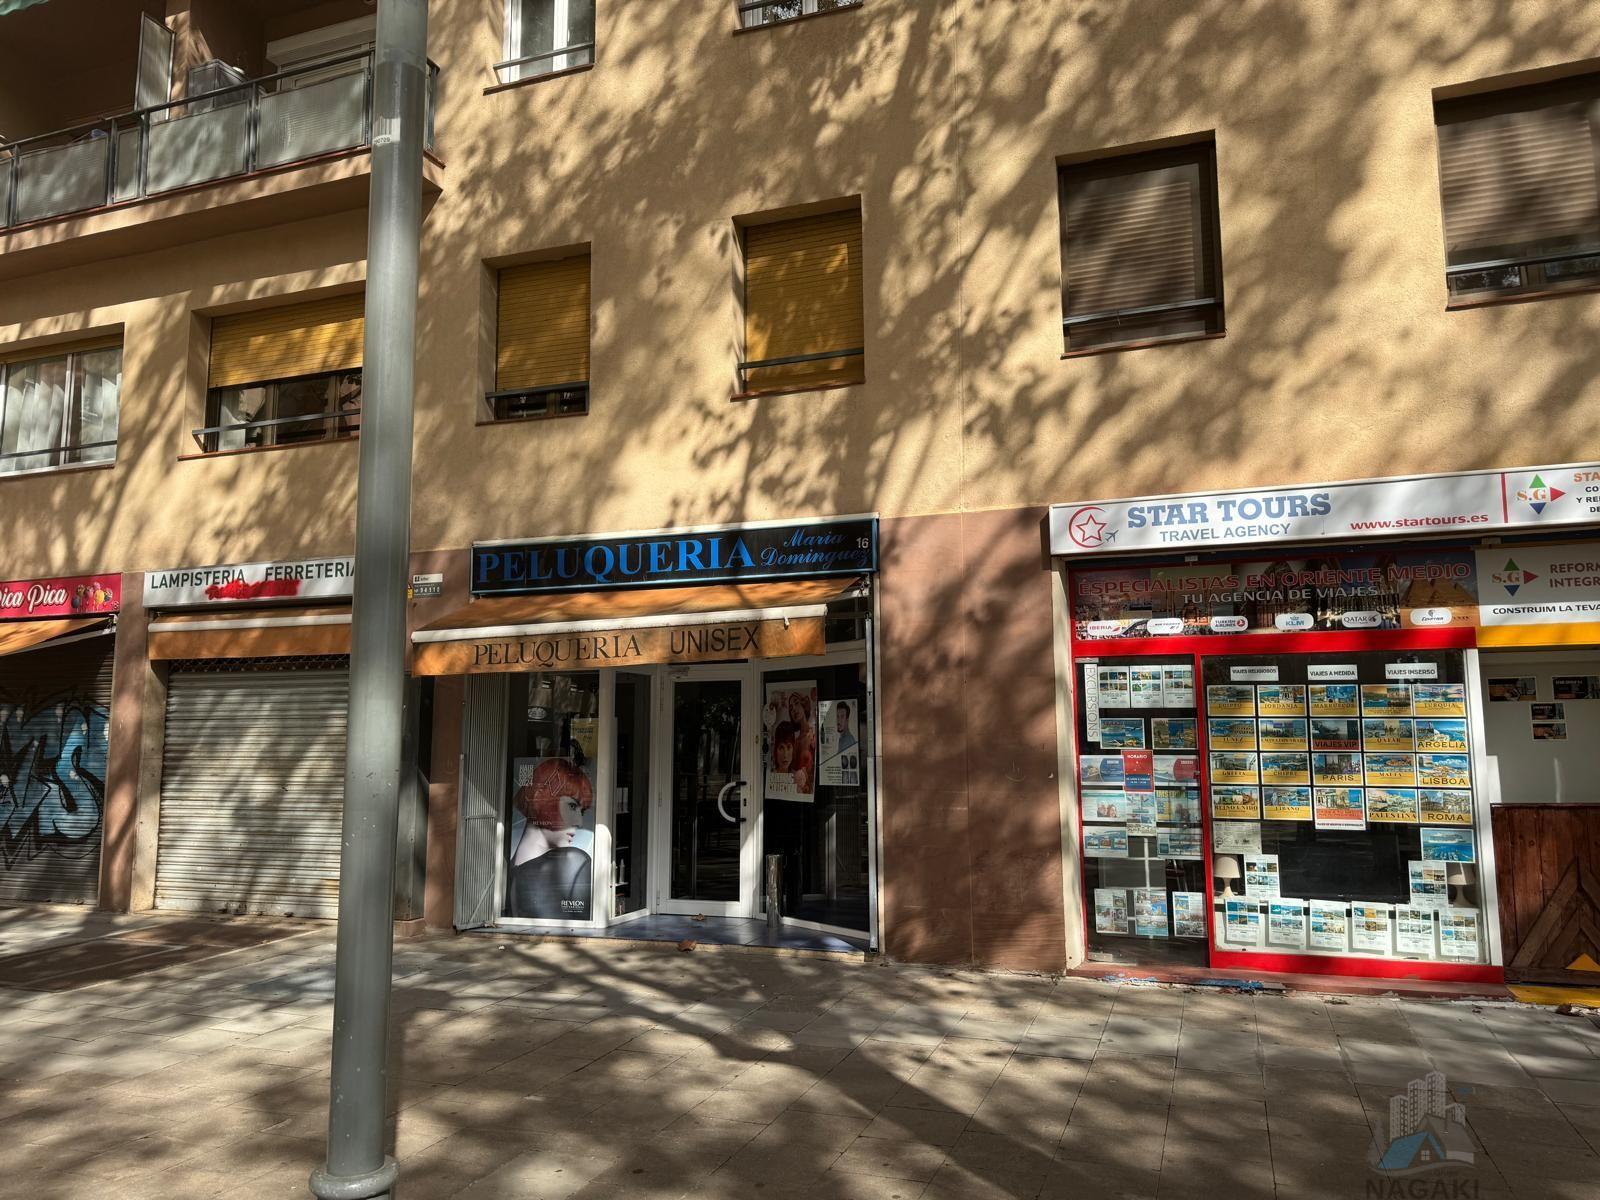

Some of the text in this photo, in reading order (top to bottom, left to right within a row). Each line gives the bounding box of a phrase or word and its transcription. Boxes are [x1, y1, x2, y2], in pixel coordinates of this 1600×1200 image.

[1128, 493, 1331, 528] STAR TOURS
[1350, 513, 1489, 530] www.startours.es
[783, 528, 847, 548] Maria
[1160, 523, 1291, 543] TRAVEL AGENCY
[856, 537, 869, 549] 16
[477, 535, 757, 584] PELUQUERIA
[151, 568, 246, 589] LAMPISTERIA
[1246, 573, 1275, 588] EN
[1281, 567, 1382, 586] ORIENTE
[1387, 563, 1471, 581] MEDIO
[1549, 575, 1600, 588] INTEGR
[0, 583, 68, 614] ica Pica
[1182, 585, 1379, 604] TU AGENCIA DE VIAJES
[1493, 604, 1556, 615] CONSTRUIM
[1560, 604, 1573, 612] LA
[1285, 619, 1305, 627] KLM
[472, 626, 760, 668] PELUQUERIA UNISEX
[1085, 667, 1099, 738] EXCURSIONS
[1315, 740, 1341, 748] VIAJES
[1344, 740, 1358, 748] VIP
[1417, 741, 1467, 749] ARGELIA
[1422, 777, 1466, 785] LISBOA
[1427, 813, 1465, 821] ROMA
